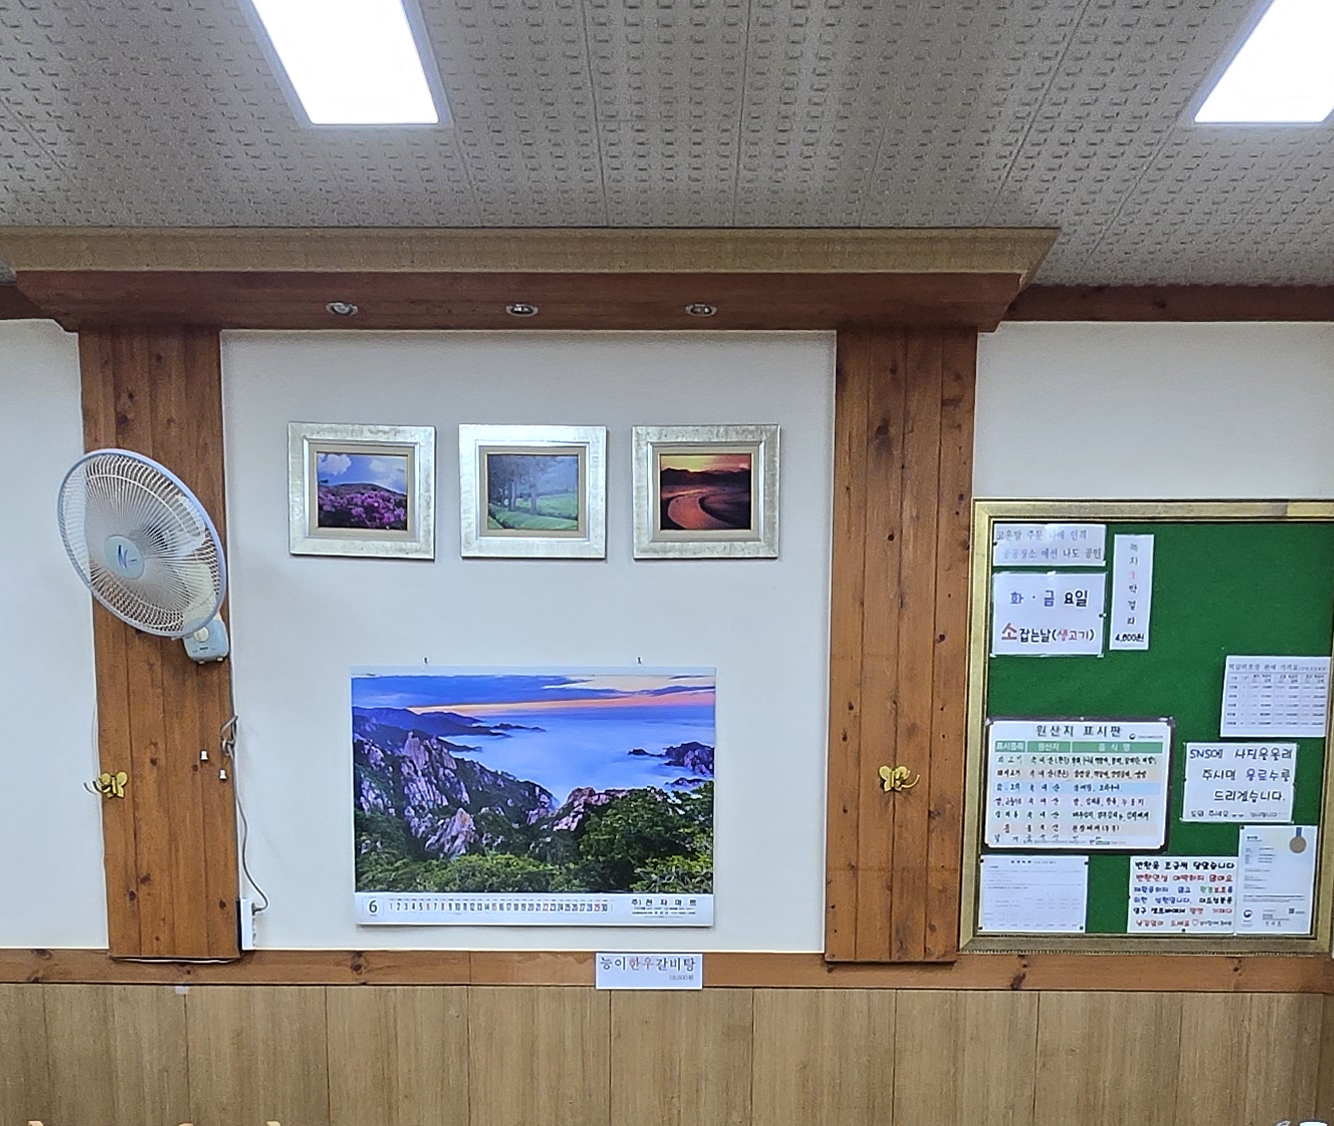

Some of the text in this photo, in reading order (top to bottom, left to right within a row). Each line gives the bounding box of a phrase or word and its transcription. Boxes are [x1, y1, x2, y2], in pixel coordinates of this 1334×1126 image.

[1063, 548, 1079, 560] 나도
[1010, 590, 1088, 607] 화 금 요일
[1001, 623, 1095, 644] 소잡는날(생고기)
[1036, 725, 1122, 737] 원산지 표시판
[1190, 747, 1223, 760] SNS에
[1202, 768, 1290, 781] 주시면 음료수를
[1214, 790, 1286, 803] 드리겠습니다.
[1135, 861, 1159, 870] 반찬을
[369, 900, 378, 913] 6
[600, 956, 696, 972] 능이한우갈비탕
